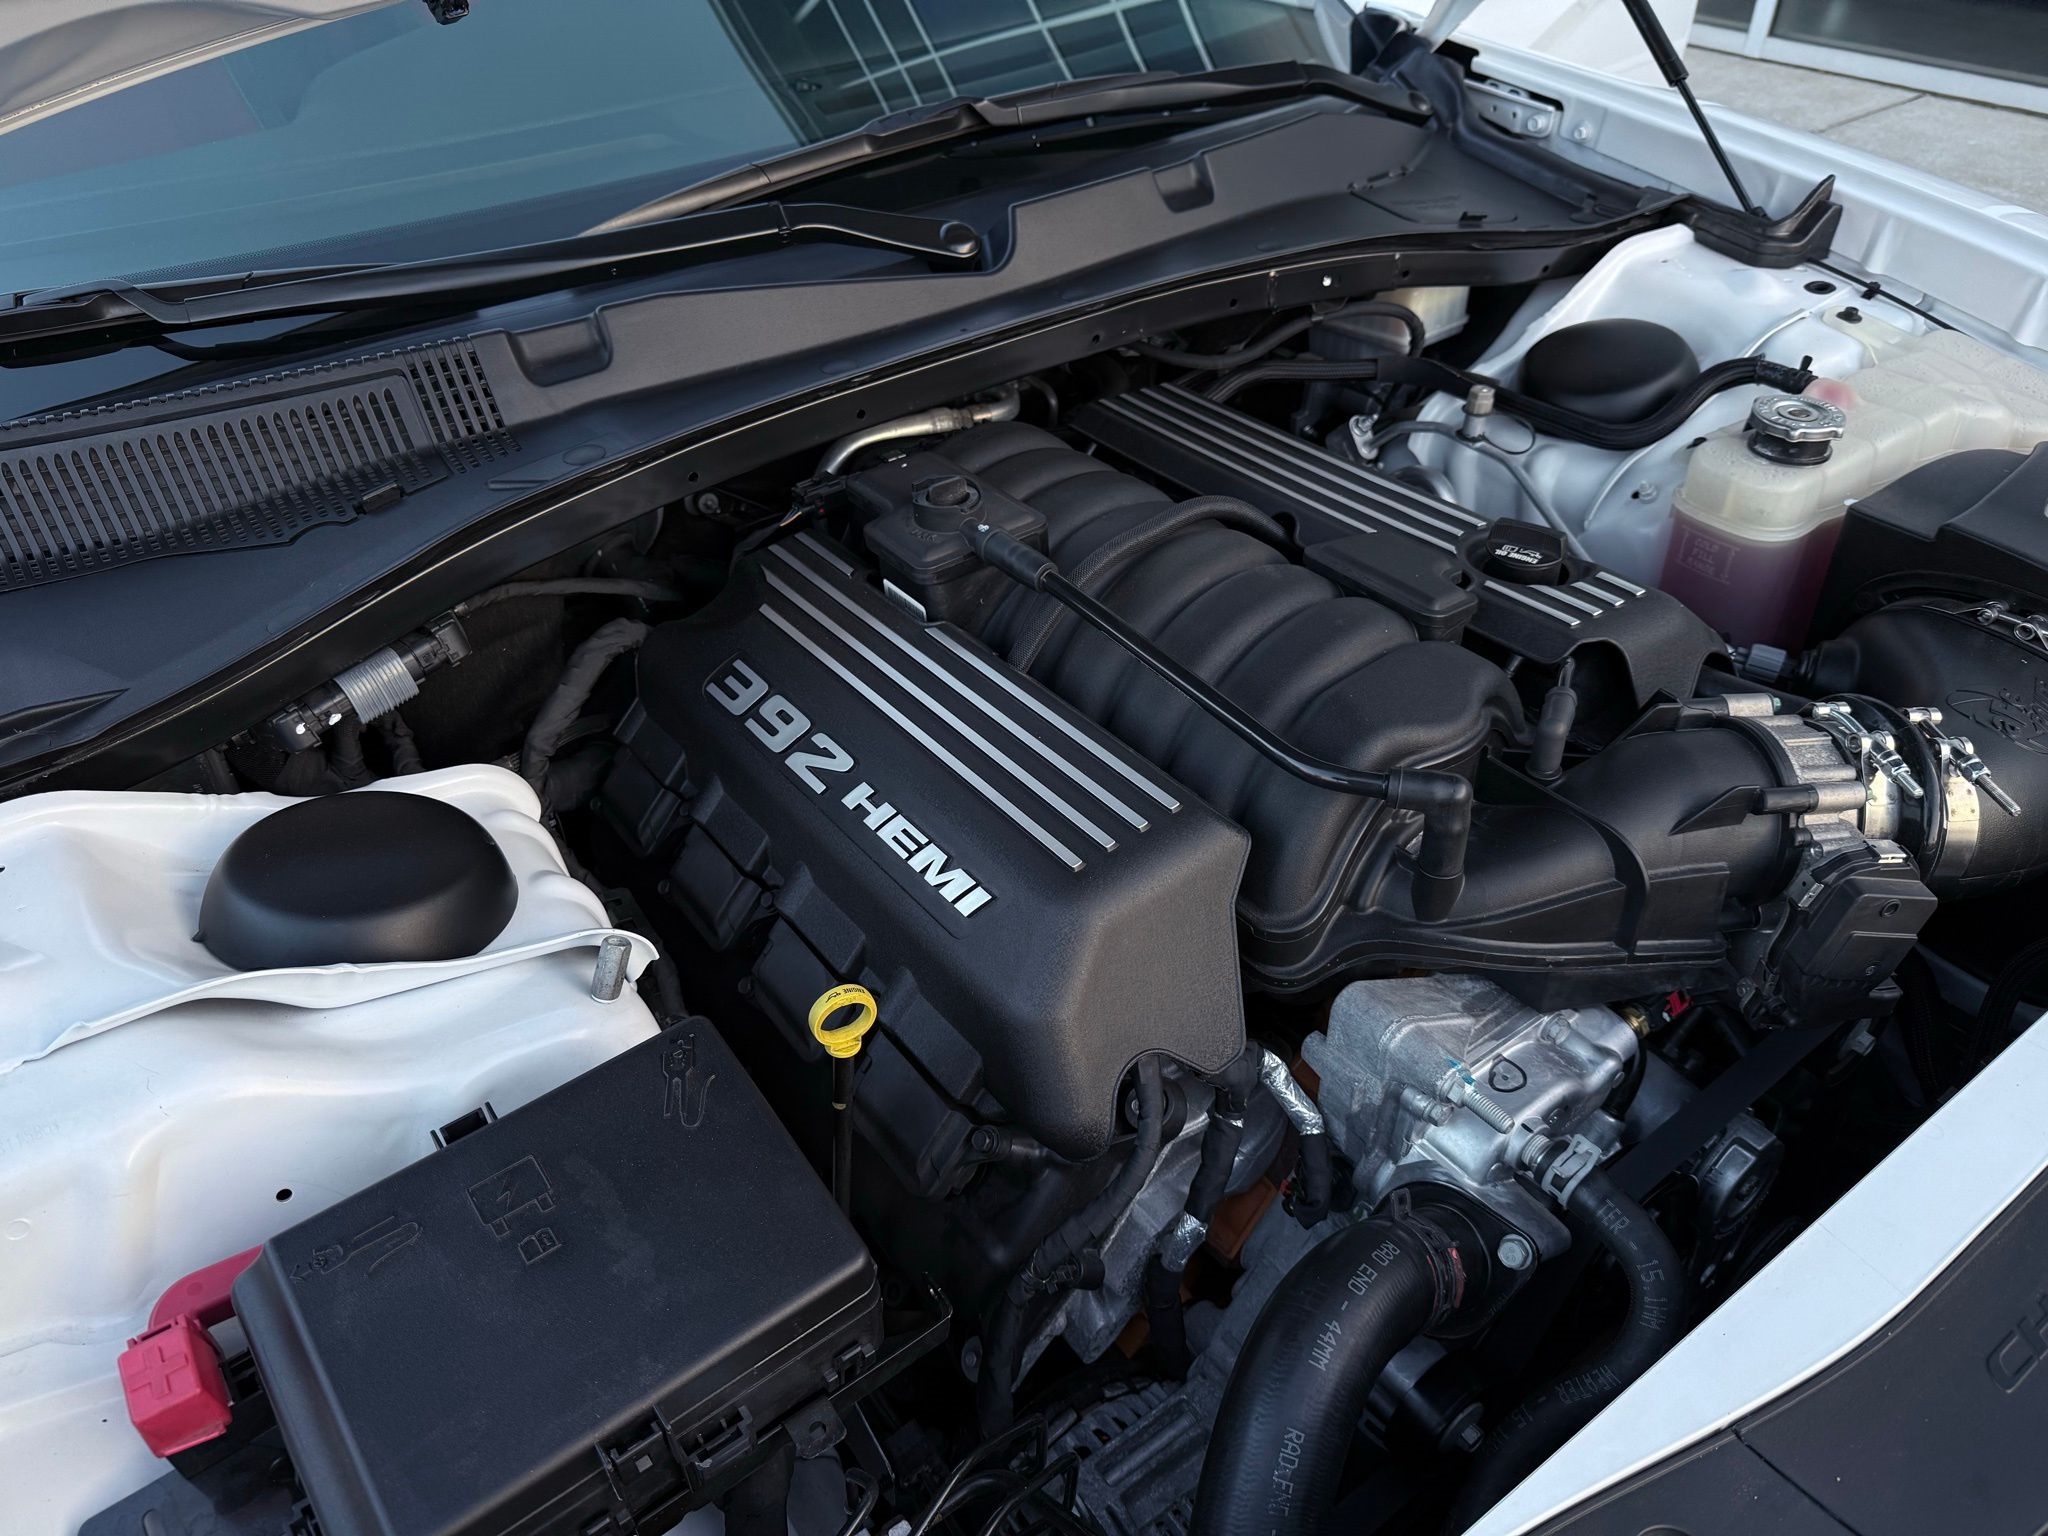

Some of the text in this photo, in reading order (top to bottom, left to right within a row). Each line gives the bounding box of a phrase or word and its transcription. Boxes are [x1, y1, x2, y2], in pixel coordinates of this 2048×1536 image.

[1494, 548, 1540, 564] ENGINE OIL
[1690, 548, 1715, 564] FILL
[705, 658, 993, 918] 392 HEMI
[1371, 1239, 1400, 1267] RAD
[1347, 1262, 1378, 1297] END
[1307, 1319, 1342, 1372] 44MM
[1278, 1425, 1306, 1471] RAD
